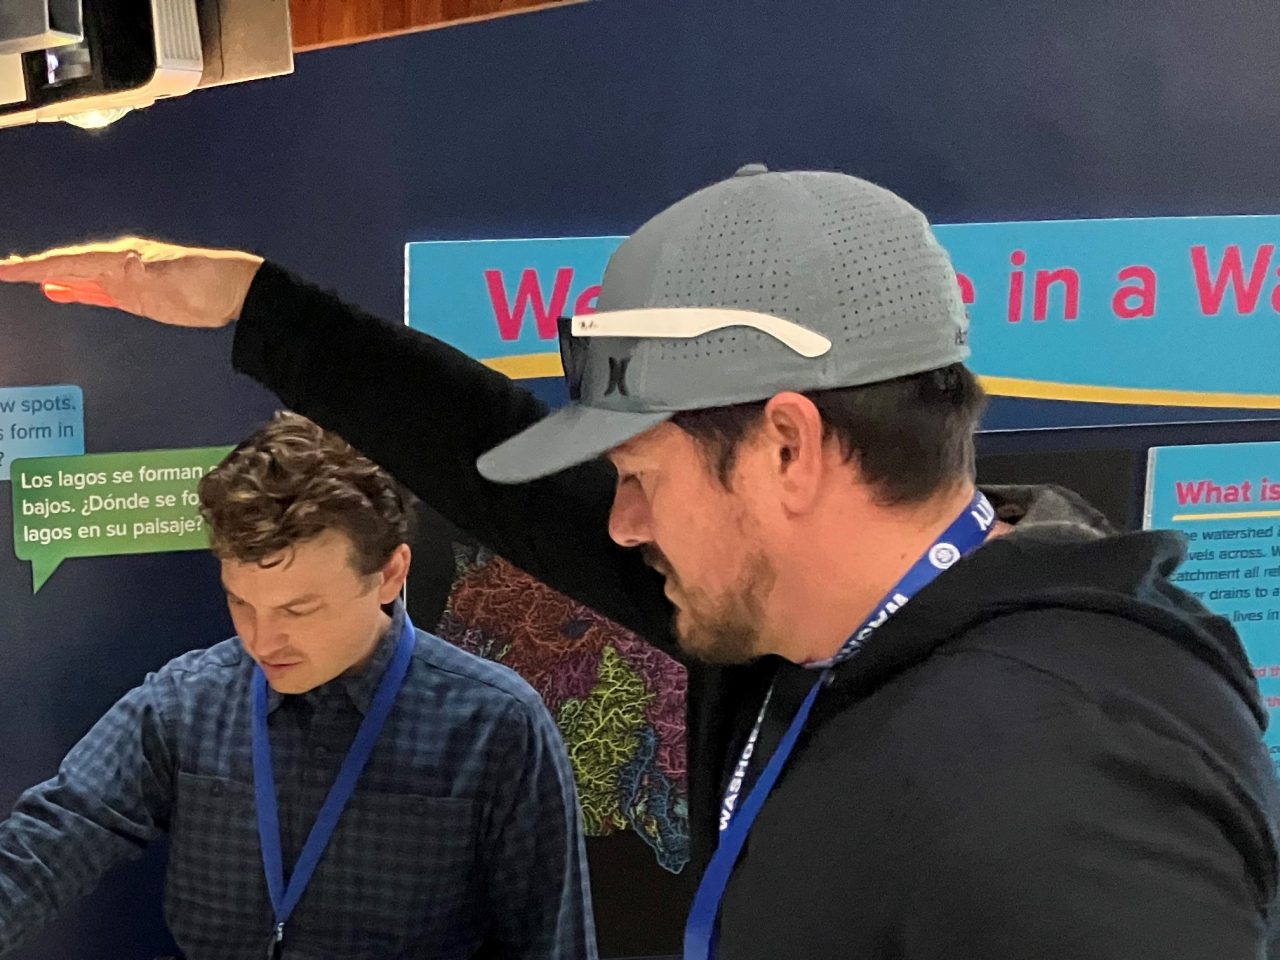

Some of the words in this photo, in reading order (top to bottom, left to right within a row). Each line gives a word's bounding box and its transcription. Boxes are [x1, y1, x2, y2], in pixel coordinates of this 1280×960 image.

[1008, 250, 1081, 323] in
[1111, 265, 1157, 319] a
[20, 395, 77, 415] spots.
[10, 423, 52, 440] form
[58, 421, 74, 438] in
[21, 472, 53, 489] Los
[58, 470, 107, 490] lagos
[112, 470, 134, 484] se
[138, 465, 203, 482] forman
[1176, 480, 1251, 505] What
[22, 498, 76, 519] bajos.
[81, 492, 150, 516] ¿Dónde
[155, 494, 177, 508] se
[23, 525, 73, 545] lagos
[77, 525, 101, 539] en
[106, 523, 127, 537] su
[133, 515, 204, 539] paisaje?
[1202, 526, 1273, 541] watershed
[1219, 548, 1266, 560] across.
[1244, 566, 1260, 579] all
[1209, 587, 1251, 601] drains
[1255, 586, 1269, 598] to
[1233, 610, 1263, 622] lives
